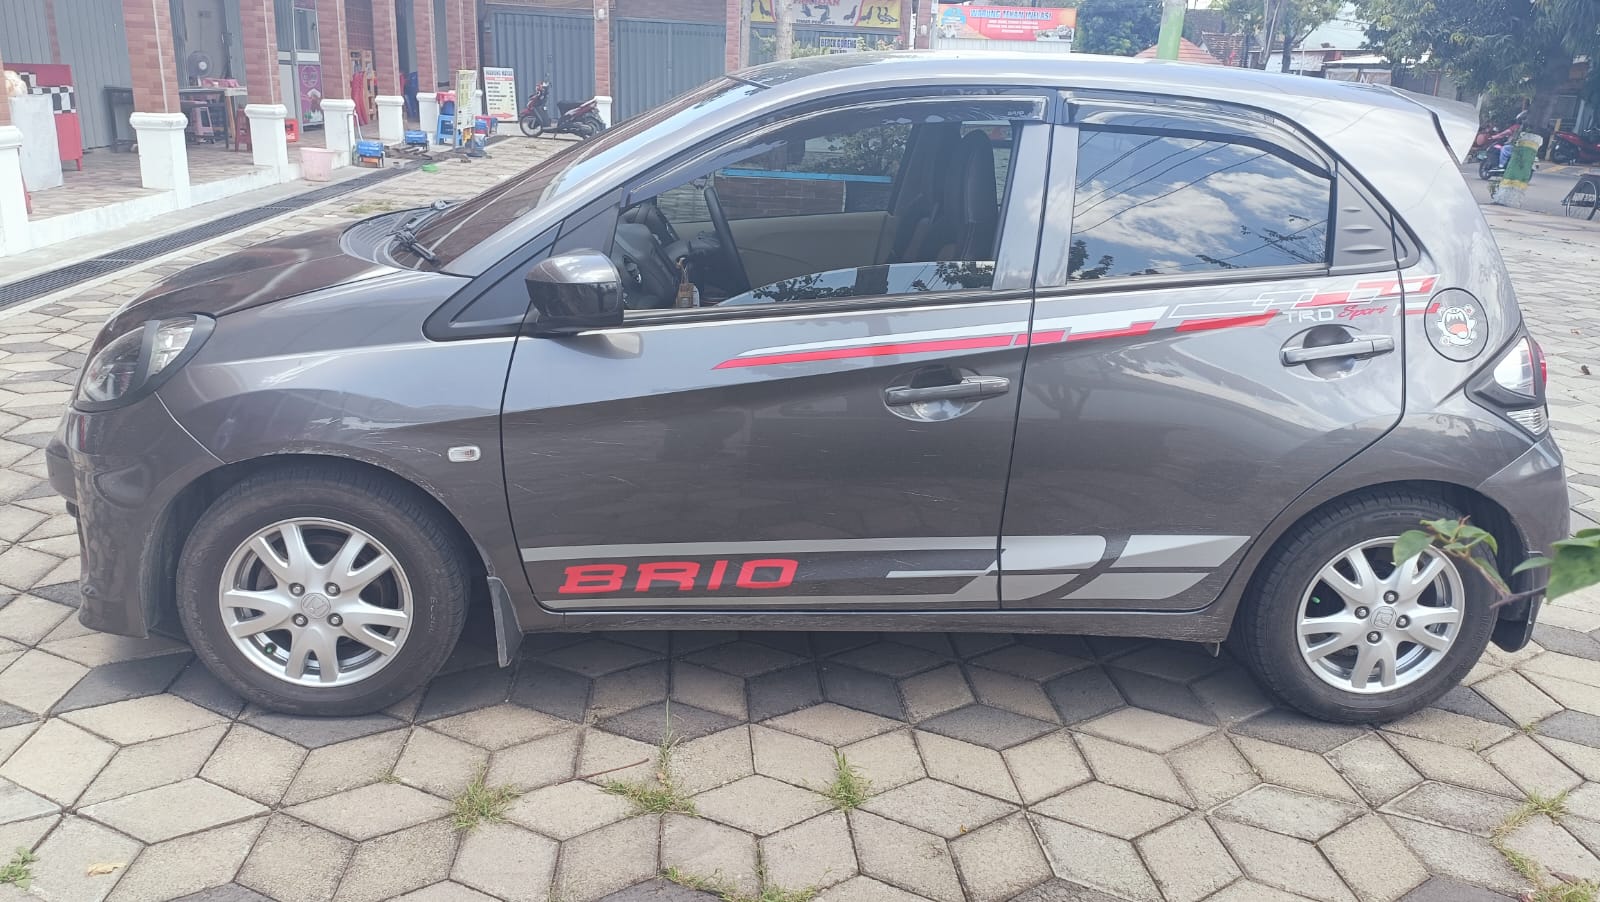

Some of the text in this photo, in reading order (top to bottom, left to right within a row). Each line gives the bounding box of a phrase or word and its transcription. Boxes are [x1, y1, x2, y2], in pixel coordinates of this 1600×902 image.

[969, 9, 1001, 18] WARUNG
[1283, 304, 1389, 323] TRD Sport
[558, 558, 799, 594] BRIO
